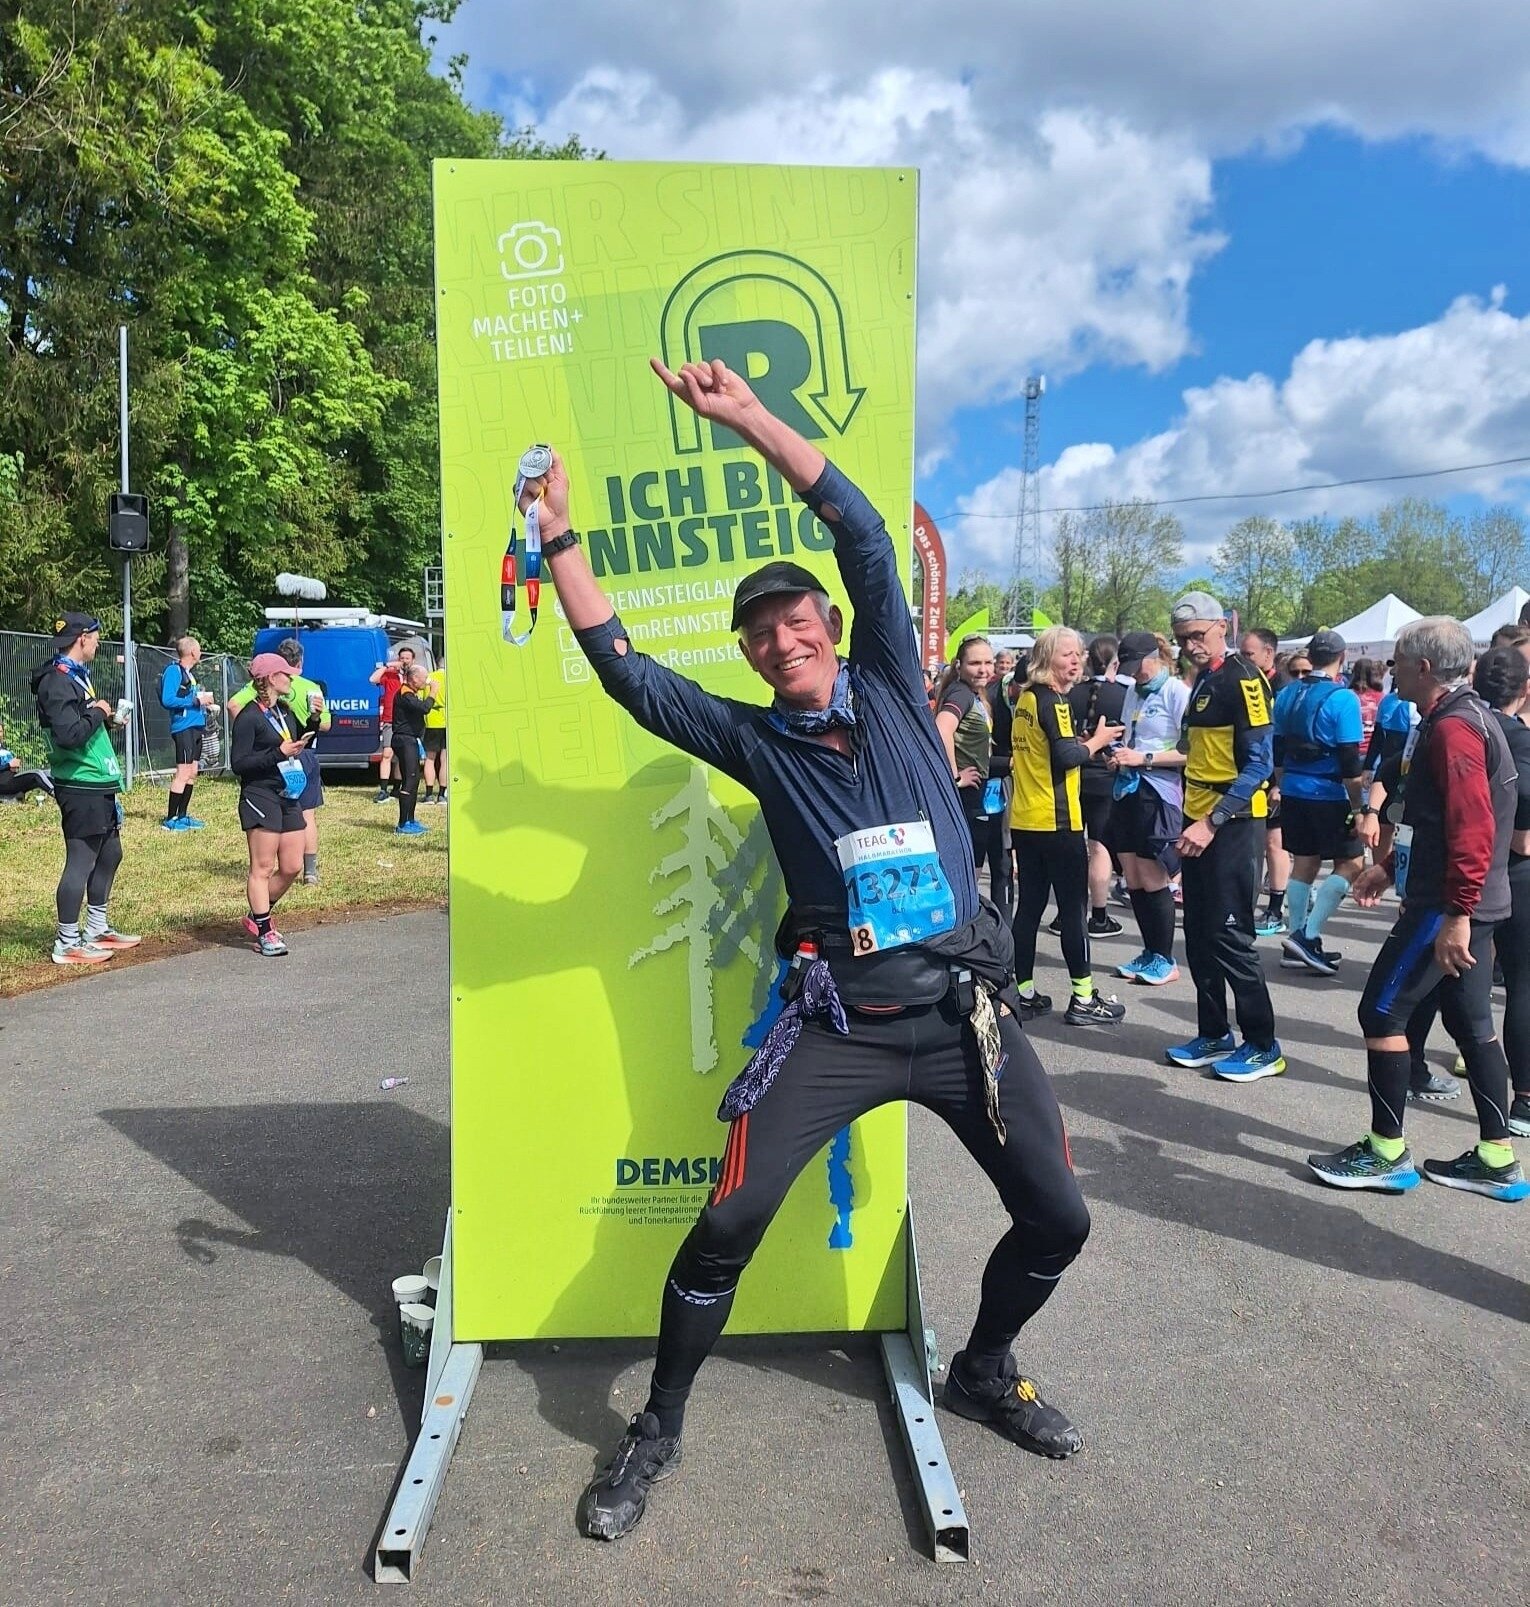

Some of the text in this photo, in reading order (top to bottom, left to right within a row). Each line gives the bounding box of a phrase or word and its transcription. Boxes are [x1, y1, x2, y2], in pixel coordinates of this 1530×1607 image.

[507, 282, 567, 310] FOTO
[472, 307, 584, 339] MACHEN+
[490, 332, 574, 362] TEILEN!
[606, 459, 804, 525] ICH BI
[914, 525, 932, 550] Das
[926, 549, 942, 604] schönste
[928, 606, 942, 630] Ziel
[927, 630, 940, 651] der
[857, 834, 888, 850] TEAG
[846, 862, 943, 910] 13271
[857, 927, 874, 951] 8
[579, 1206, 625, 1216] Rückführung
[626, 1206, 646, 1214] leerer
[602, 1195, 649, 1205] bundesweiter
[652, 1195, 678, 1204] Partner
[679, 1195, 690, 1204] für
[691, 1194, 703, 1204] die
[629, 1217, 643, 1225] und
